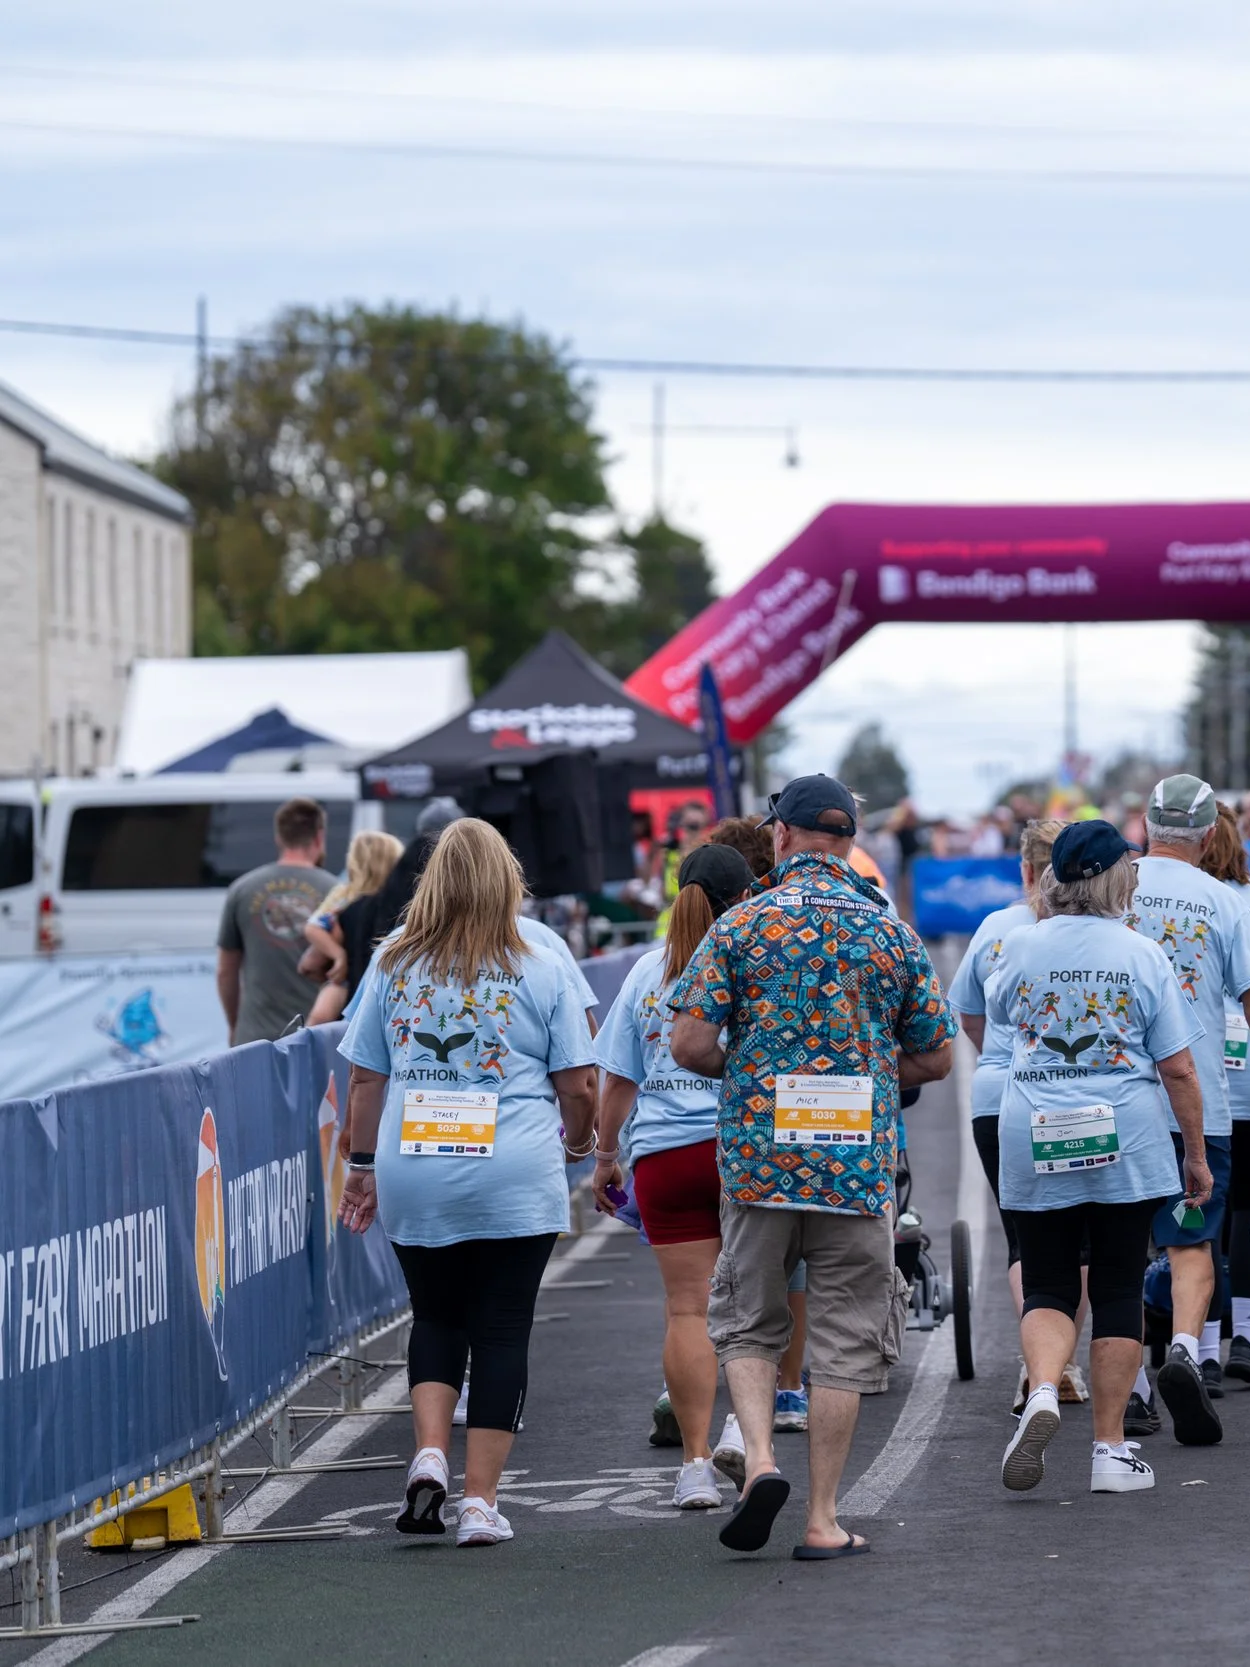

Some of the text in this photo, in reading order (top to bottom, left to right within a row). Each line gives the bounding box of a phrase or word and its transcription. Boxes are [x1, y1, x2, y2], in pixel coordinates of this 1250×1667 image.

[755, 568, 810, 612] Bank
[917, 566, 1097, 602] Bendigo Bank
[468, 703, 637, 733] Stockdale
[527, 722, 637, 748] Leggo
[804, 896, 810, 904] A
[810, 897, 855, 909] CONVERSATION
[855, 903, 881, 914] STARTER
[1133, 895, 1216, 918] PORT FAIRY
[476, 969, 524, 988] FAIRY
[1050, 970, 1092, 984] PORT
[1013, 1068, 1088, 1083] MARATHON
[644, 1079, 714, 1091] MARATHON
[796, 1097, 818, 1105] MICK
[432, 1110, 459, 1121] STACEY
[811, 1110, 836, 1120] 5030
[437, 1124, 461, 1133] 5029
[1064, 1140, 1085, 1149] 4215
[20, 1233, 71, 1373] FARY
[76, 1205, 168, 1352] MARATHON
